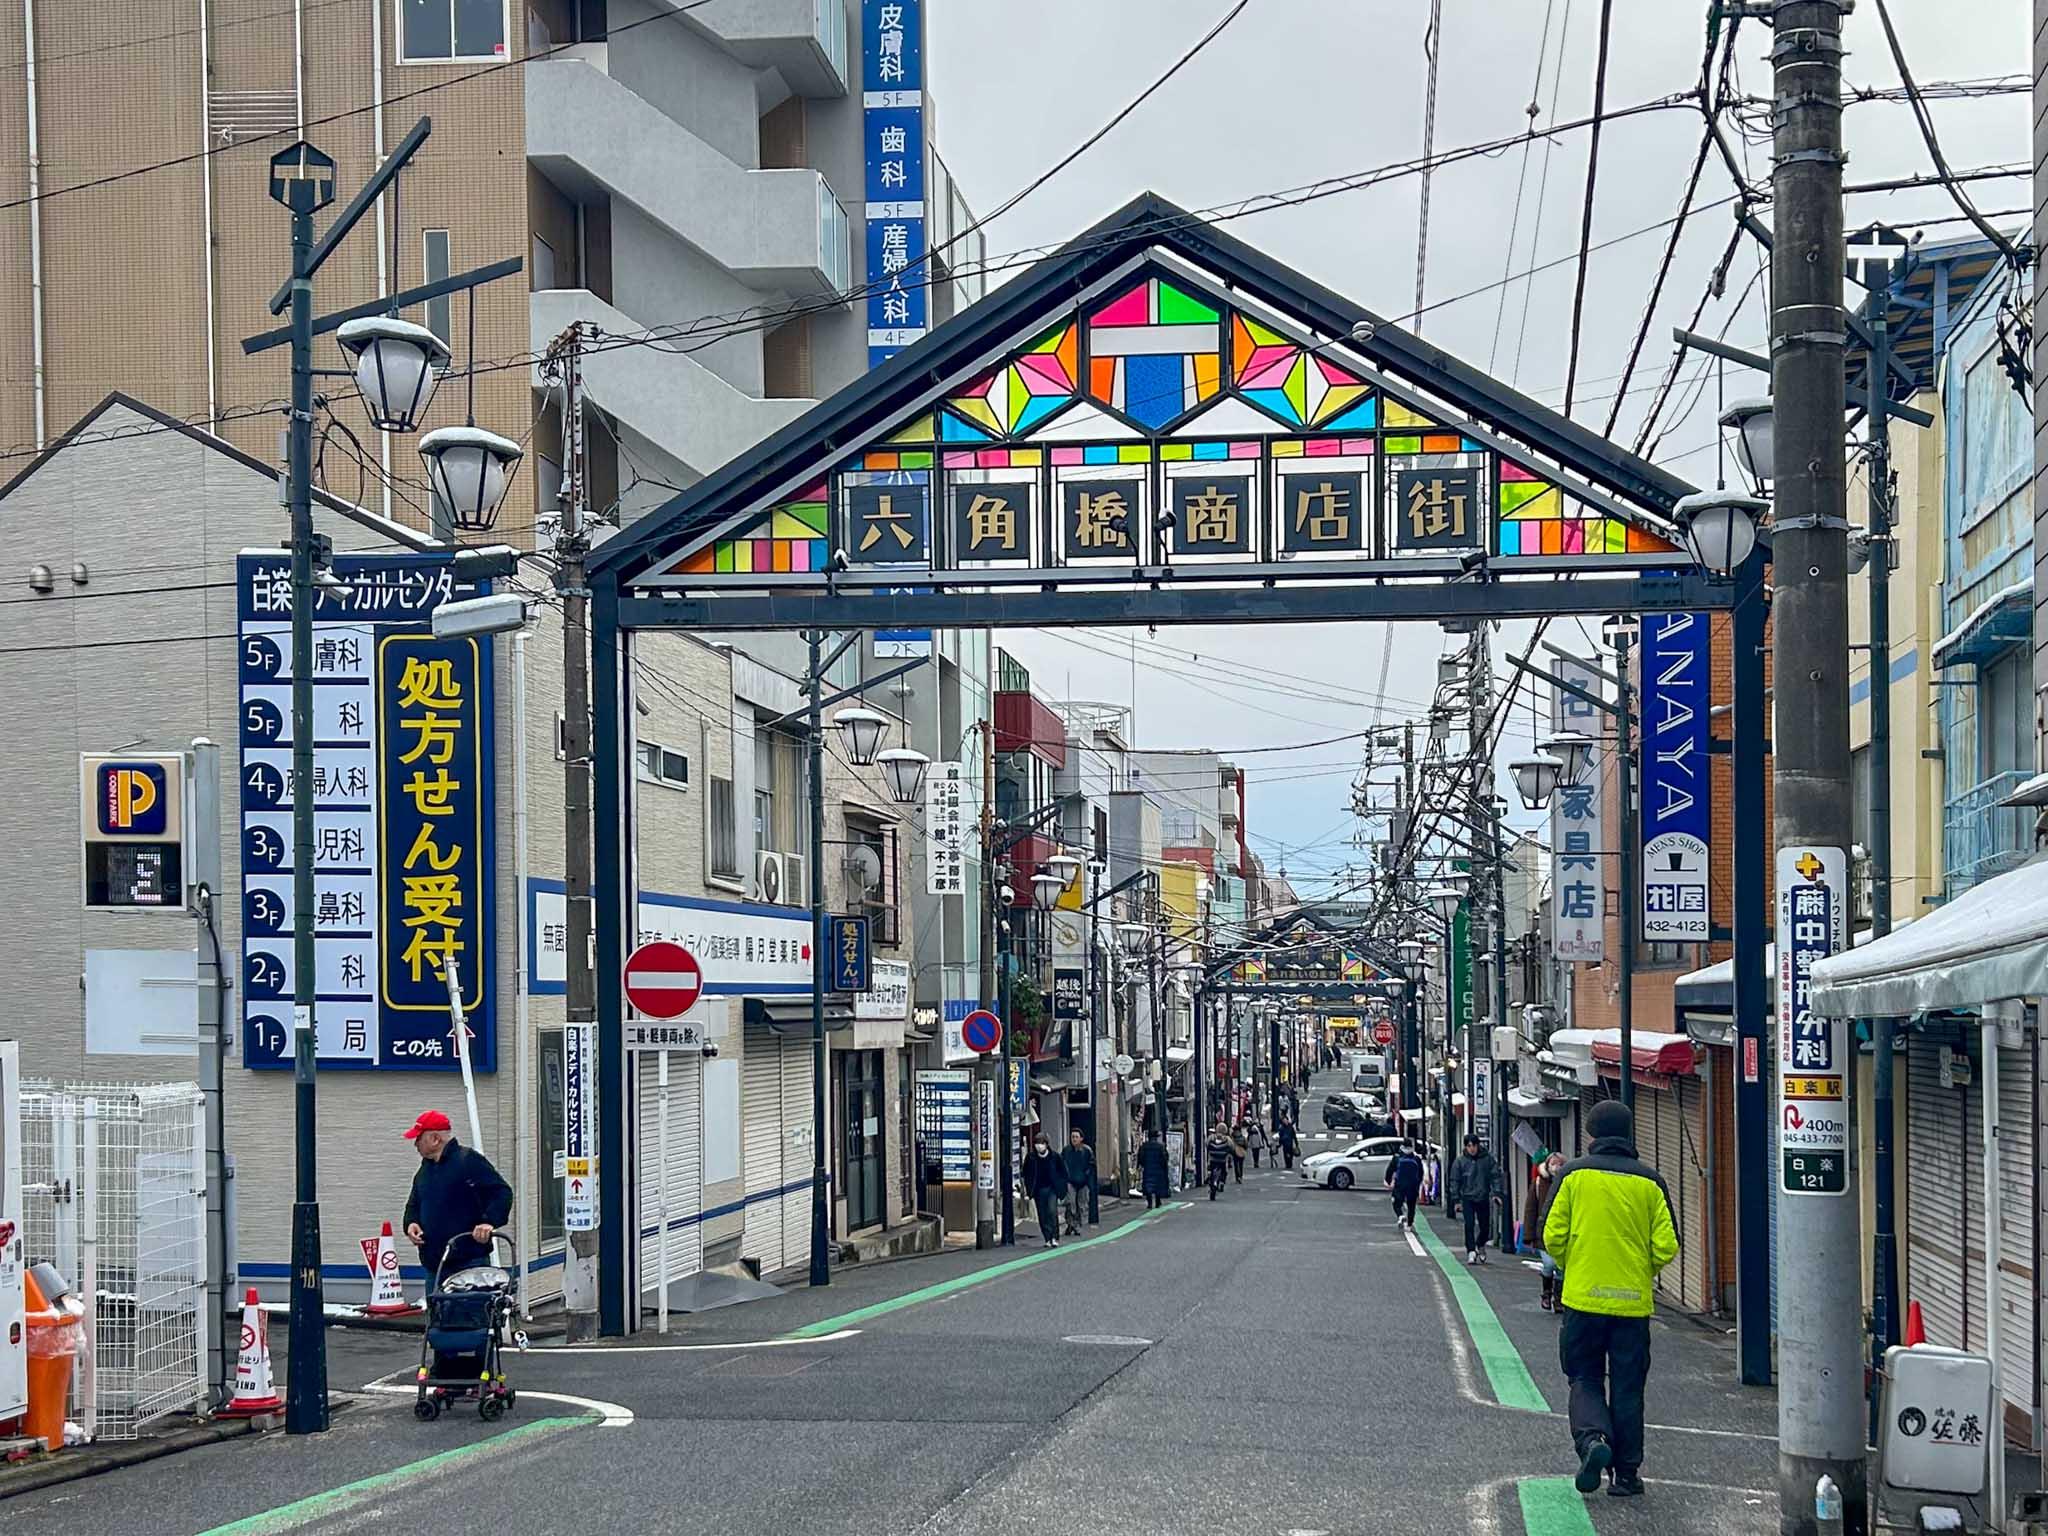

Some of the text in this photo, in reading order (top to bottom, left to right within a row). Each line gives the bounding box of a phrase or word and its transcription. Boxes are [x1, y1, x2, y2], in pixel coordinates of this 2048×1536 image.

[879, 4, 904, 82] 皮膚科
[882, 93, 903, 106] 5F
[880, 126, 907, 188] 歯科
[884, 204, 904, 217] 5F
[883, 224, 909, 324] 産婦人科
[885, 331, 905, 344] 4F
[859, 479, 1467, 552] 六角橋商店街
[246, 641, 274, 670] 5F
[247, 706, 275, 735] 5F
[248, 768, 276, 799] 4F
[1560, 677, 1596, 918] 名家具店
[109, 775, 117, 823] COIN PARK
[398, 657, 464, 982] 処方せん受付
[252, 831, 277, 863] 3F
[1646, 836, 1706, 858] MEN'S SHOP
[253, 895, 278, 926] 3F
[1648, 886, 1705, 911] 花屋
[1646, 921, 1706, 932] 432-4123
[842, 922, 858, 977] 処方せん
[251, 958, 279, 987] 2F
[255, 1022, 279, 1051] 1F
[392, 1040, 443, 1057] この先
[1785, 1081, 1840, 1094] 白楽駅
[1784, 1133, 1843, 1143] 045-433-7700
[1806, 1119, 1843, 1132] 400m
[1793, 1158, 1834, 1171] 白楽
[1800, 1175, 1824, 1188] 121
[1931, 1418, 1983, 1443] 佐藤
